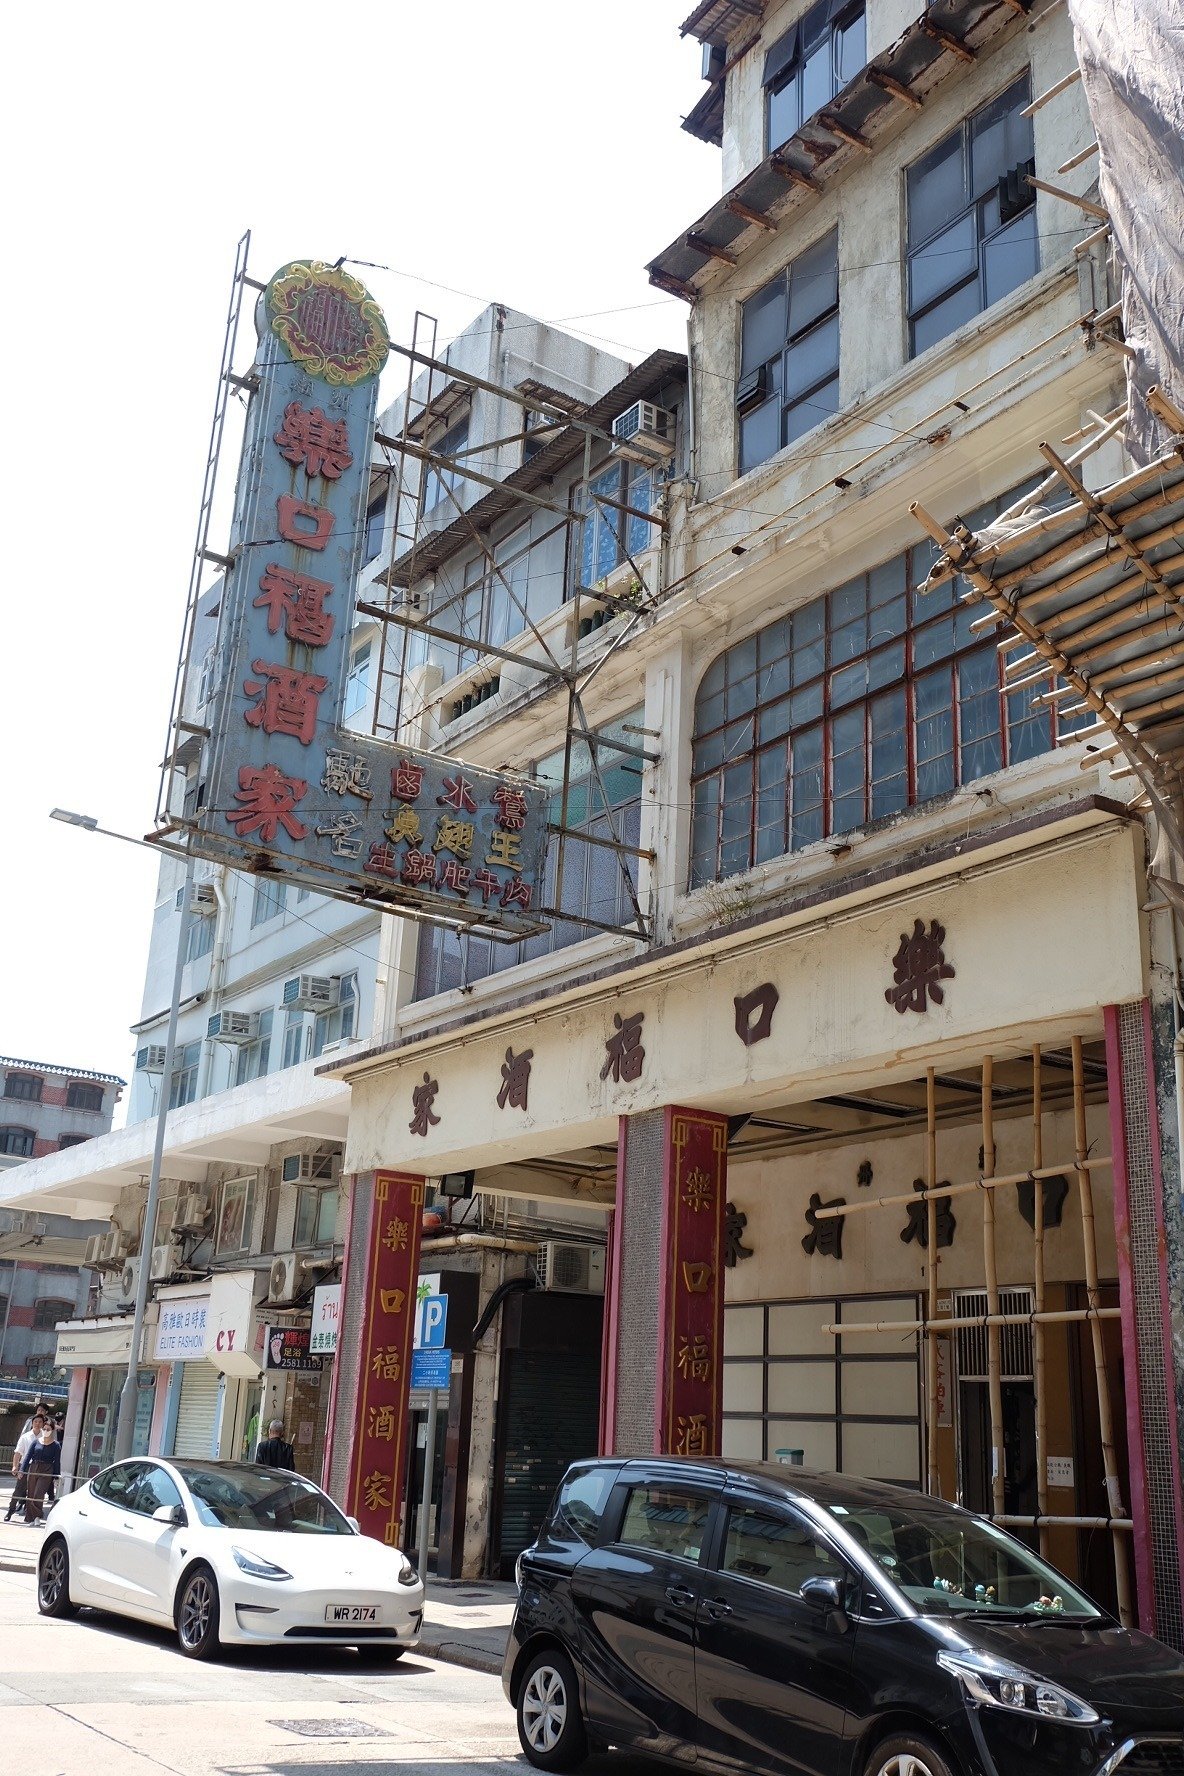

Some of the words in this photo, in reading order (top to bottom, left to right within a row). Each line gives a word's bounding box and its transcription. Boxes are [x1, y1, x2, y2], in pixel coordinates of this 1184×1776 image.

[226, 401, 354, 842] 樂口福酒家
[425, 1301, 442, 1342] P
[160, 1337, 176, 1349] ELITE
[178, 1335, 204, 1348] FASHION
[284, 1348, 302, 1357] 足浴
[282, 1359, 300, 1368] 2581
[363, 1216, 409, 1511] 樂口福酒家
[334, 1607, 349, 1621] WR
[352, 1608, 376, 1621] 2174
